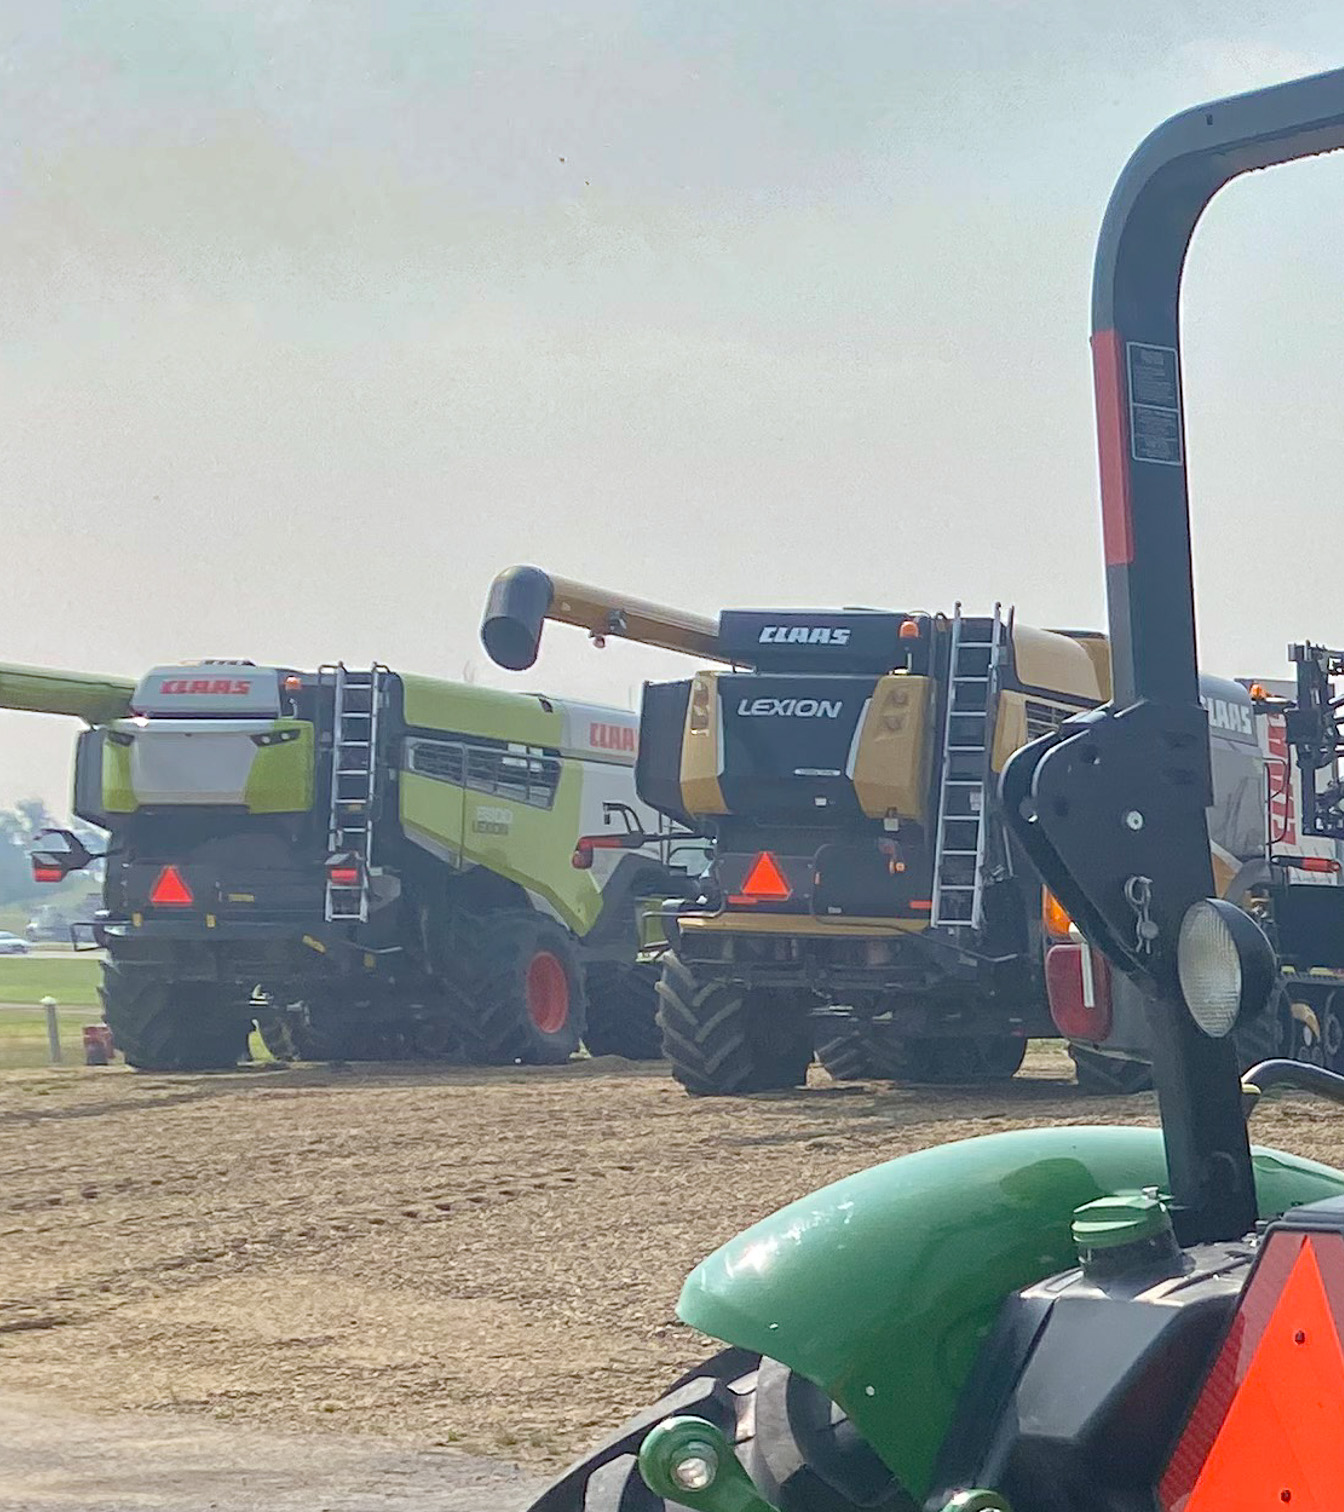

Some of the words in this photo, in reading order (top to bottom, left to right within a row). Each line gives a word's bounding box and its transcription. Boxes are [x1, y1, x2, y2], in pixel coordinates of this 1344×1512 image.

[759, 626, 850, 645] CLAAS
[160, 680, 251, 695] CLAAS
[737, 699, 843, 718] LEXION
[589, 722, 639, 752] CLAA
